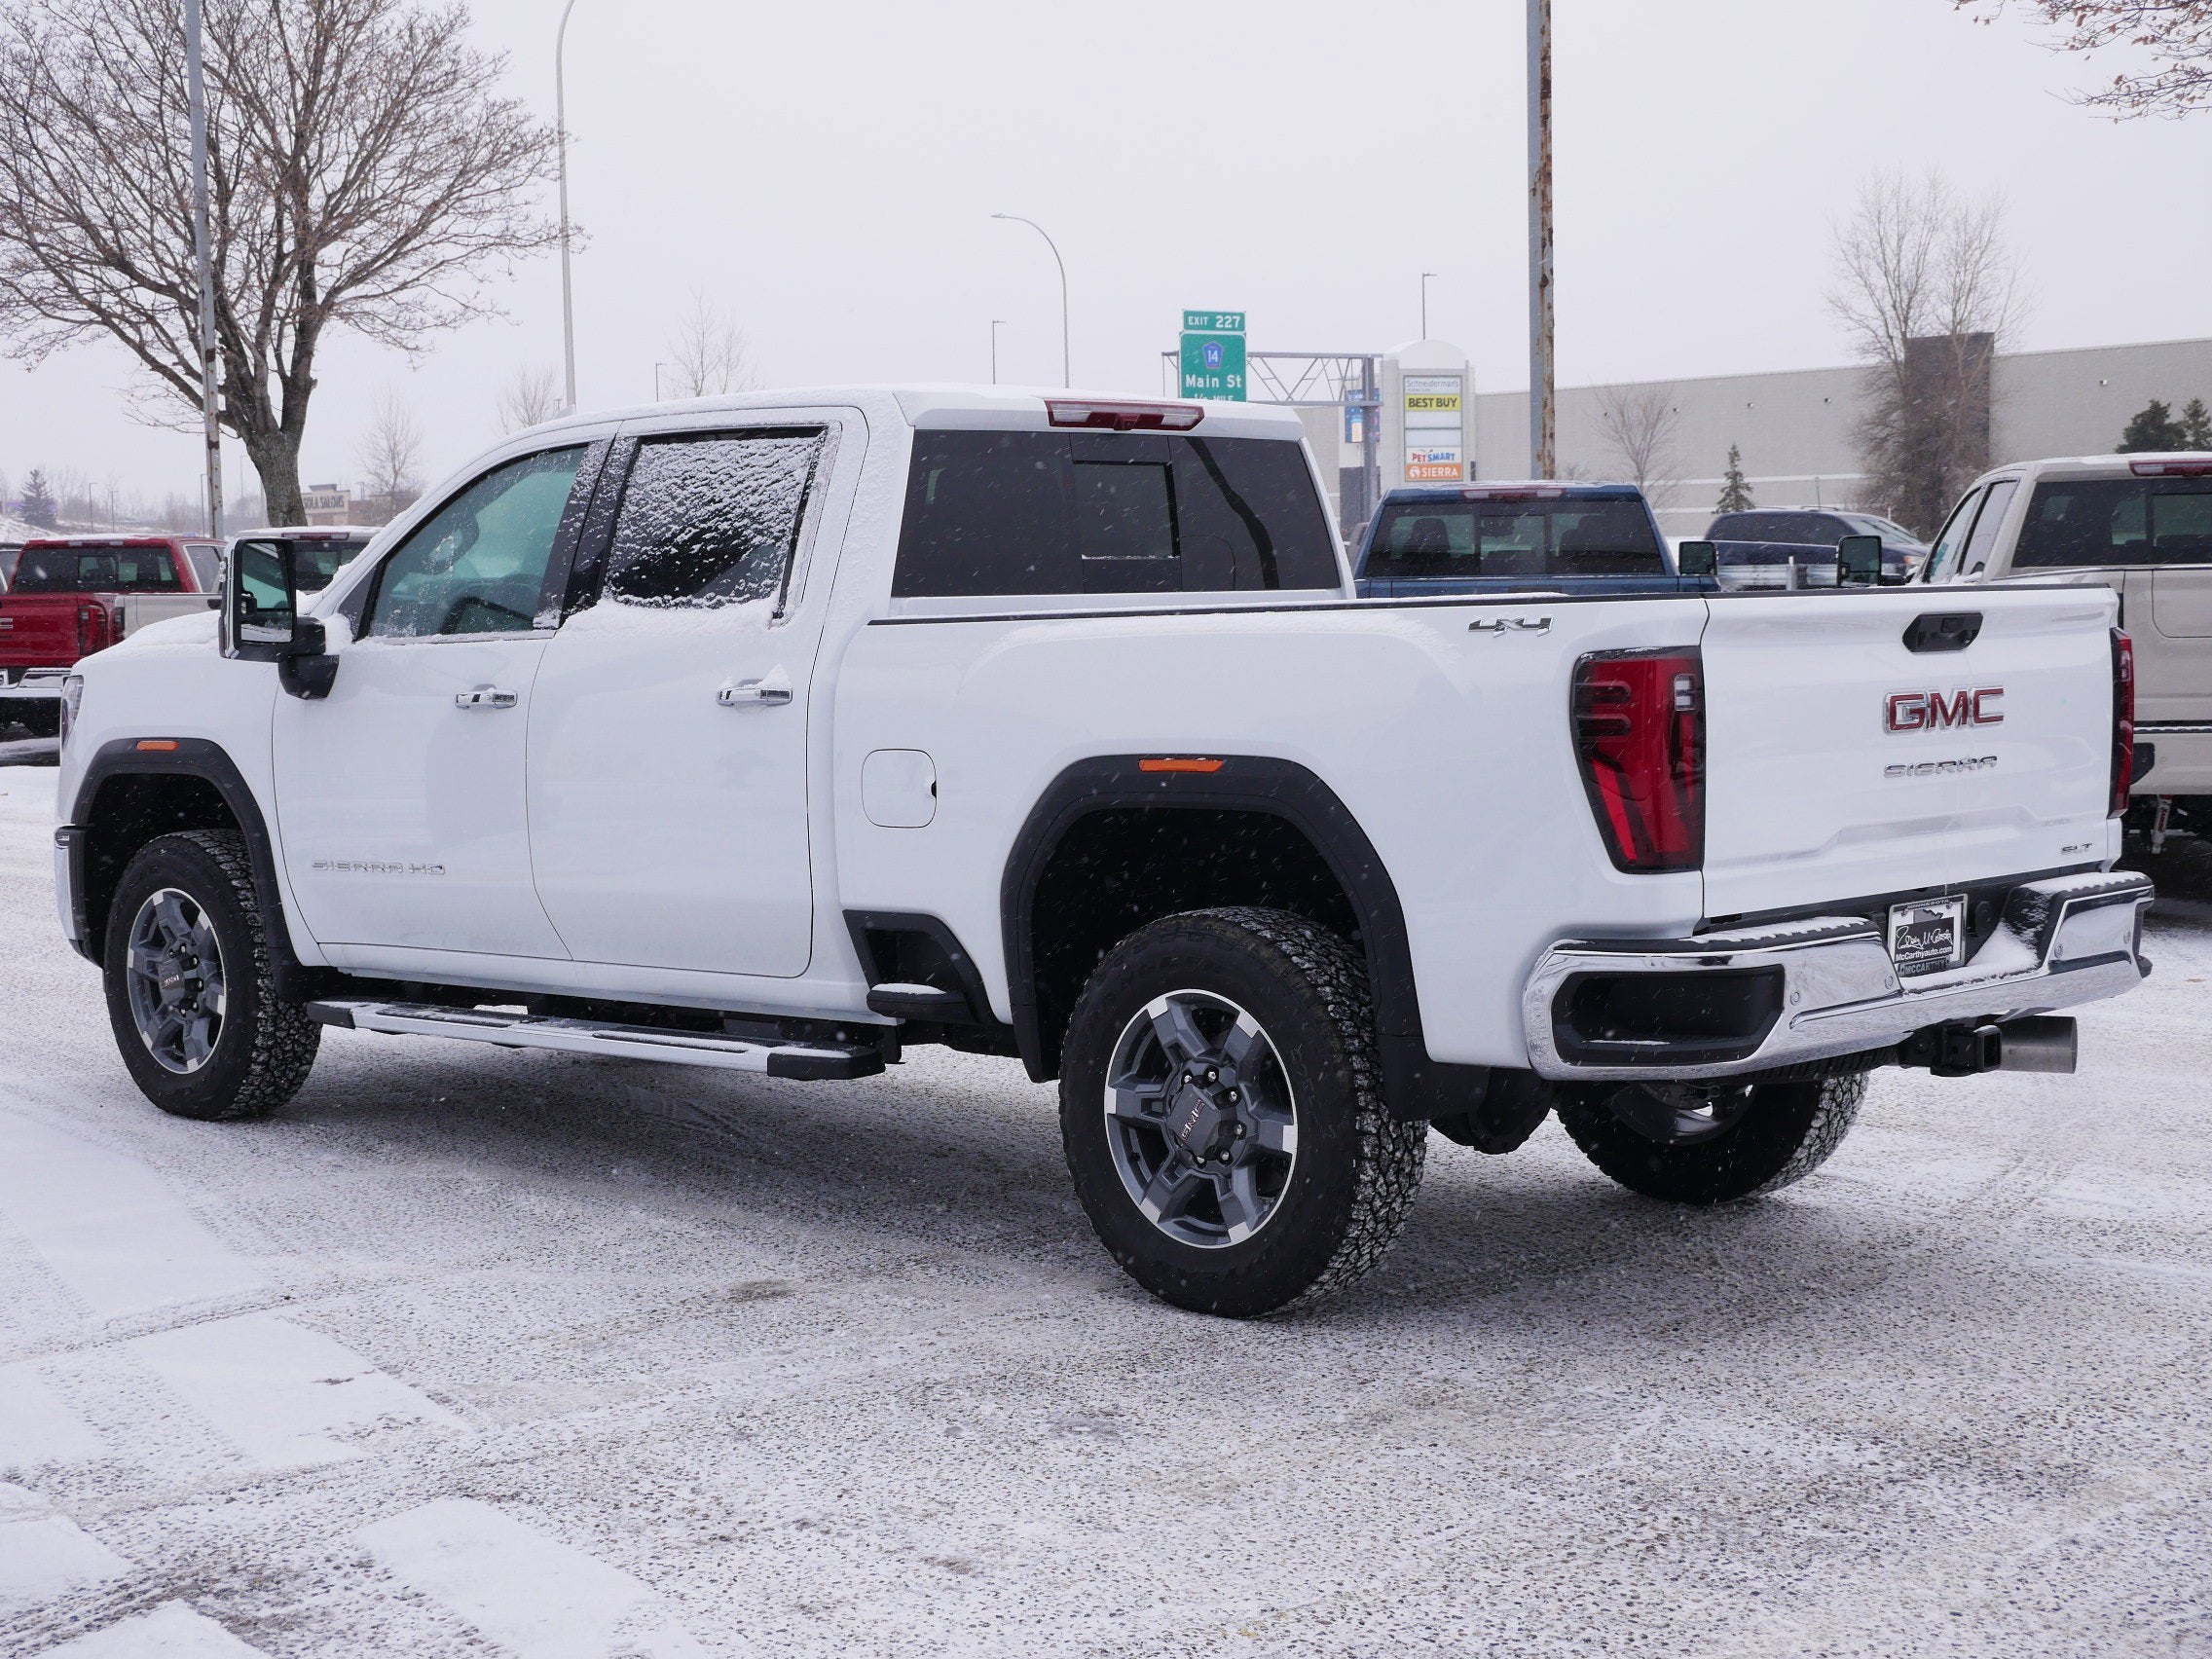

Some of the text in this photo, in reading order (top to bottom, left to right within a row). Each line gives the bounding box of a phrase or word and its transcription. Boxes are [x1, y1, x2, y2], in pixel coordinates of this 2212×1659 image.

[1188, 314, 1240, 328] EXIT 227
[1207, 350, 1219, 363] 14
[1185, 374, 1242, 387] Main St
[1408, 397, 1457, 408] BEST BUY
[1421, 467, 1458, 477] SIERRA
[1883, 685, 2004, 734] GMC
[1884, 755, 1998, 778] SIERRA
[2060, 842, 2093, 855] SLT
[312, 861, 446, 875] SIERRA HD
[1906, 899, 1949, 909] MINNESOTA
[1896, 946, 1952, 961] McCarthyauto.com
[1904, 960, 1946, 975] MCCARTHY
[1180, 1098, 1205, 1140] GMC
